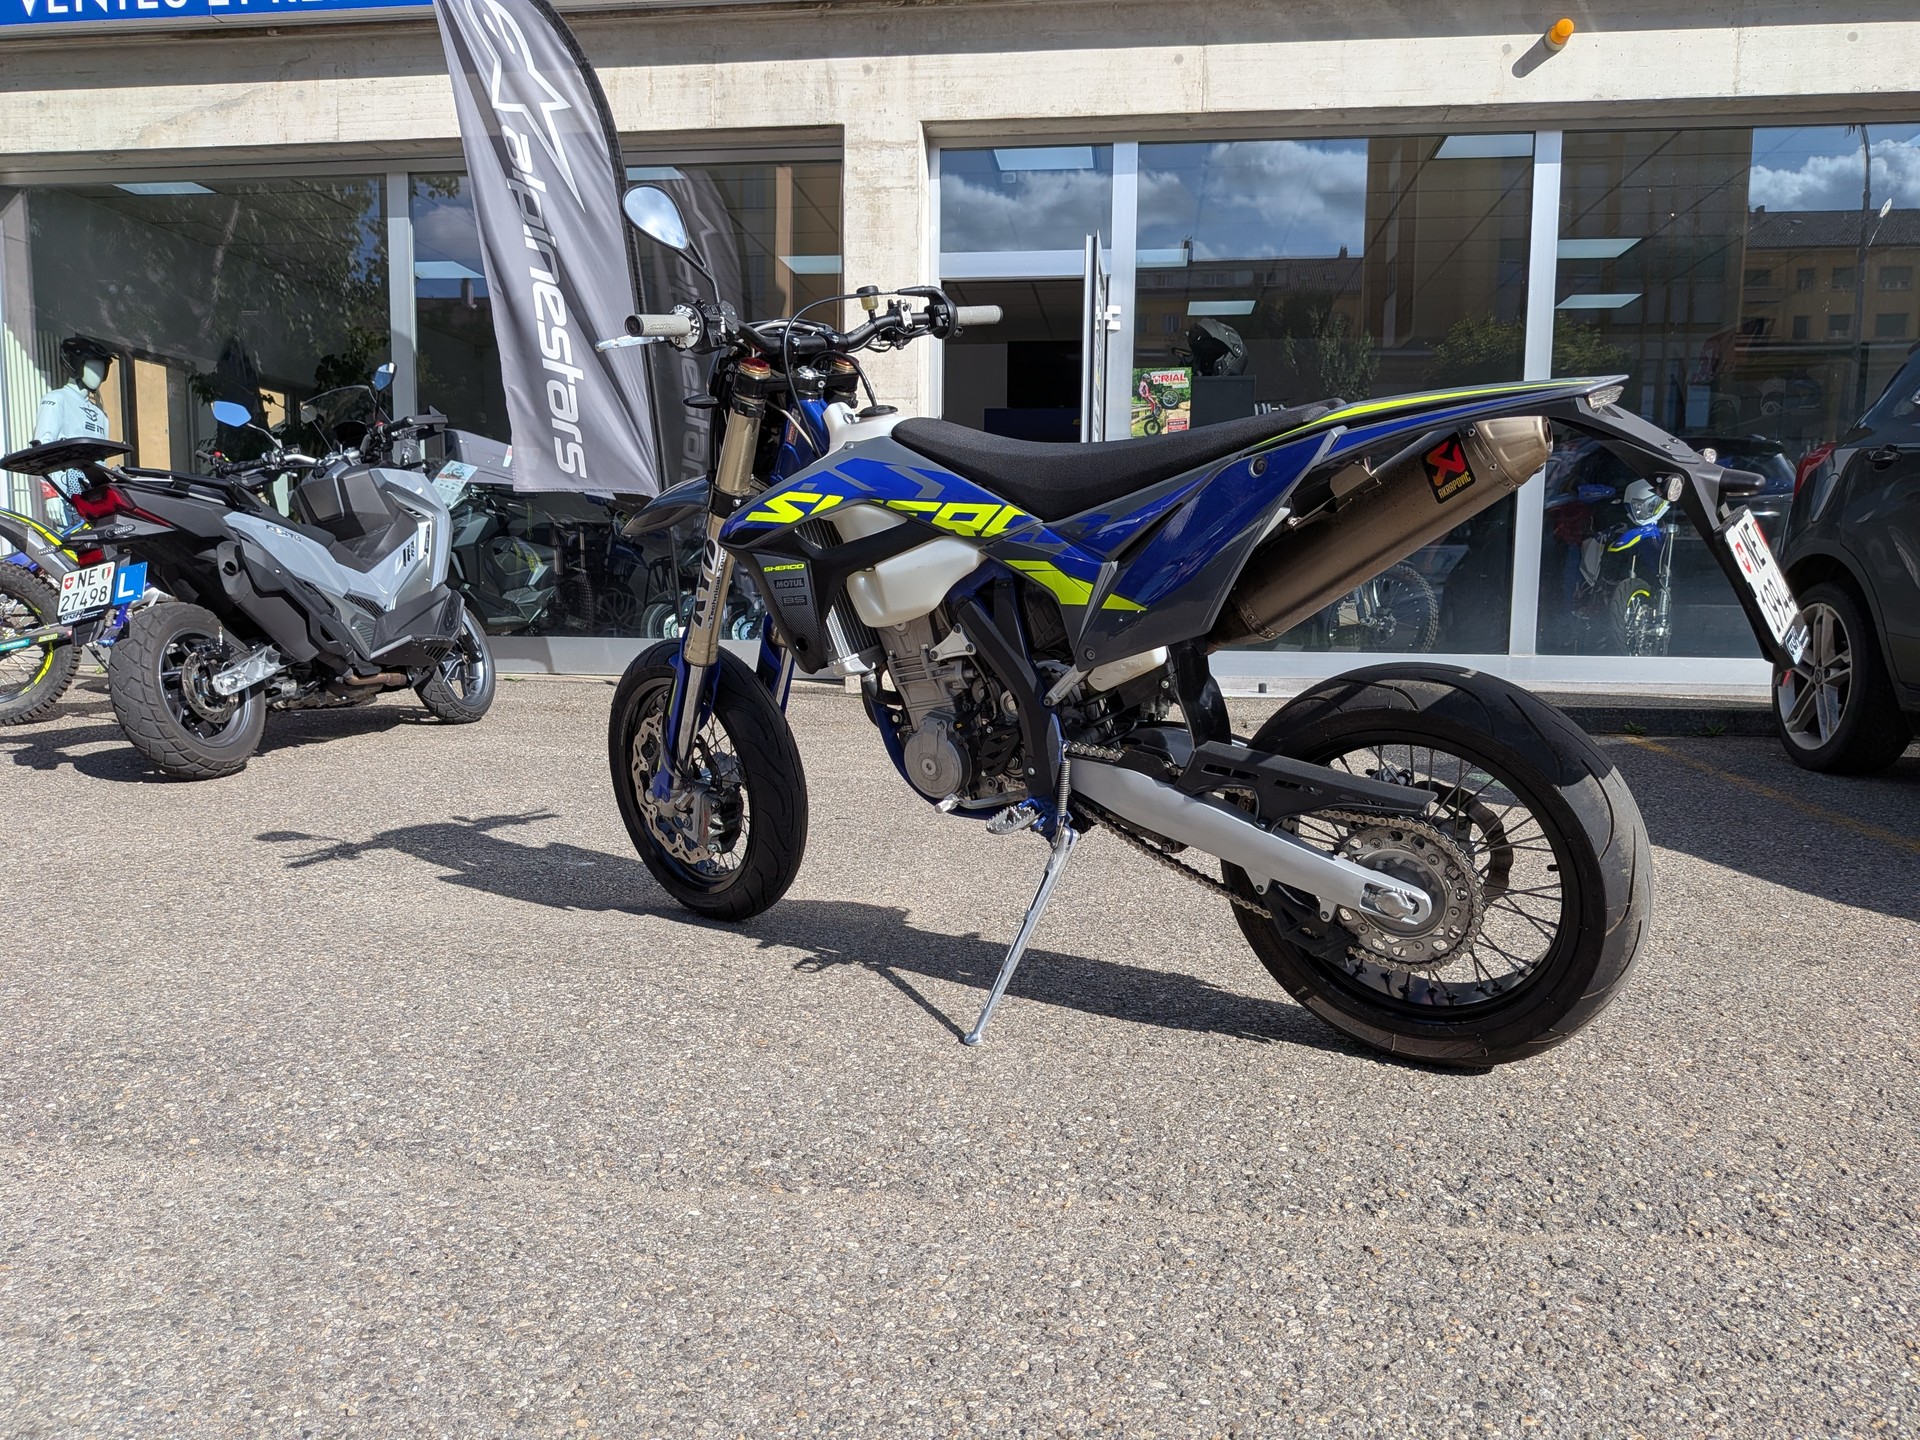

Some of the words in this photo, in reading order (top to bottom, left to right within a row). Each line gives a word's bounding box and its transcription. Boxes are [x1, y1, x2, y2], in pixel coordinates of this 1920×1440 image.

[501, 123, 588, 480] alpinestars
[1153, 373, 1186, 383] TRIAL
[77, 568, 98, 589] NE
[763, 563, 805, 572] SHERCO
[118, 572, 135, 598] L
[707, 576, 721, 622] Technical
[718, 548, 728, 574] Touc
[776, 578, 804, 588] MOTUL
[60, 586, 108, 613] 27498
